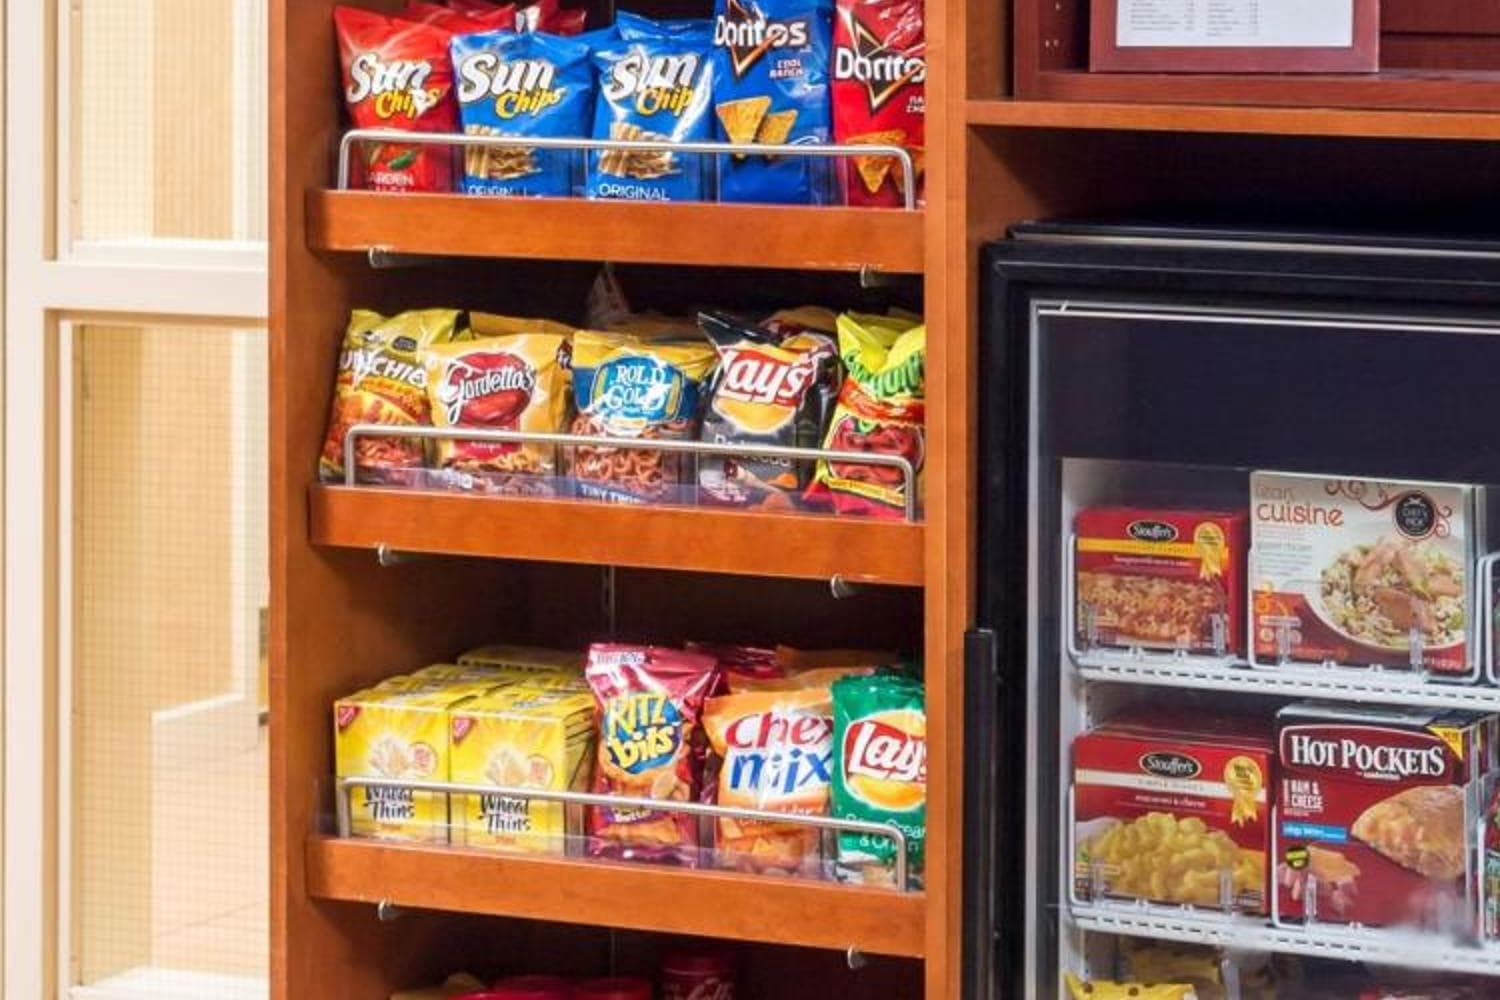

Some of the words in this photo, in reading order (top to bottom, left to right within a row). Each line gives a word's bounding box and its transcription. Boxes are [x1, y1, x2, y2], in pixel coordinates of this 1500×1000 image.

[714, 14, 808, 48] Doritos
[348, 52, 433, 105] Sun
[458, 52, 555, 102] Sun
[607, 49, 698, 101] Sun
[835, 47, 926, 82] Dorito
[495, 85, 567, 119] Chips
[636, 86, 700, 116] Chip
[599, 182, 671, 201] ORIGINAL
[439, 360, 537, 423] Gardetto's
[1256, 502, 1345, 527] cuisine
[606, 693, 668, 737] RITZ
[607, 722, 675, 769] bits
[1290, 734, 1339, 768] HOT
[1340, 739, 1446, 777] POCKETS
[729, 748, 832, 794] mix
[477, 813, 532, 834] Thins
